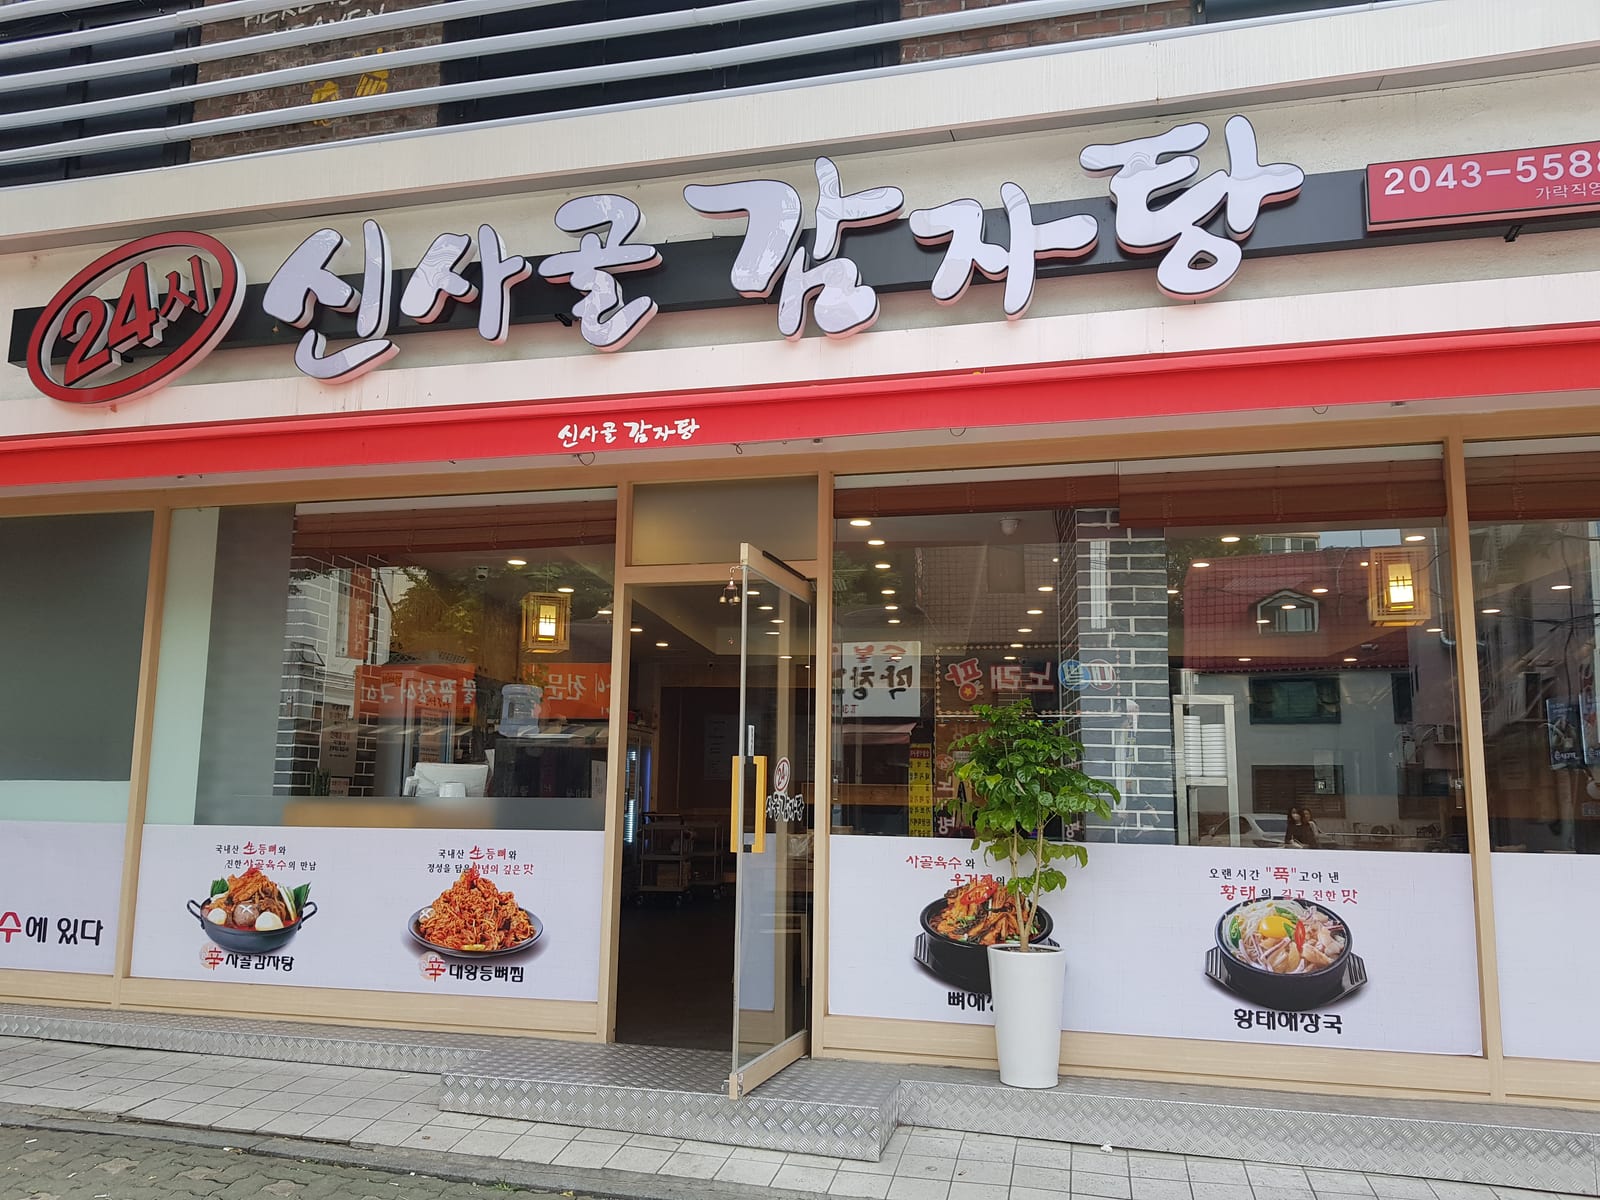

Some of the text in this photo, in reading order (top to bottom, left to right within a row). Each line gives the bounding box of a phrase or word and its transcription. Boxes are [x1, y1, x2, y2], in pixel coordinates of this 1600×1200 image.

[1384, 150, 1600, 196] 2043-558
[60, 115, 1305, 387] 24시 신사골 감자탕
[557, 418, 700, 448] 신사골 감자탕
[215, 844, 239, 855] 국내산
[438, 848, 465, 860] 국내산
[300, 861, 317, 872] 만남
[427, 863, 452, 874] 정성을
[523, 863, 535, 876] 맛
[1236, 868, 1261, 881] 시간
[1299, 870, 1322, 883] 고아
[1328, 871, 1340, 884] 낸
[1312, 889, 1337, 902] 진한
[1340, 889, 1359, 905] 맛
[0, 911, 104, 946] 수에 있다
